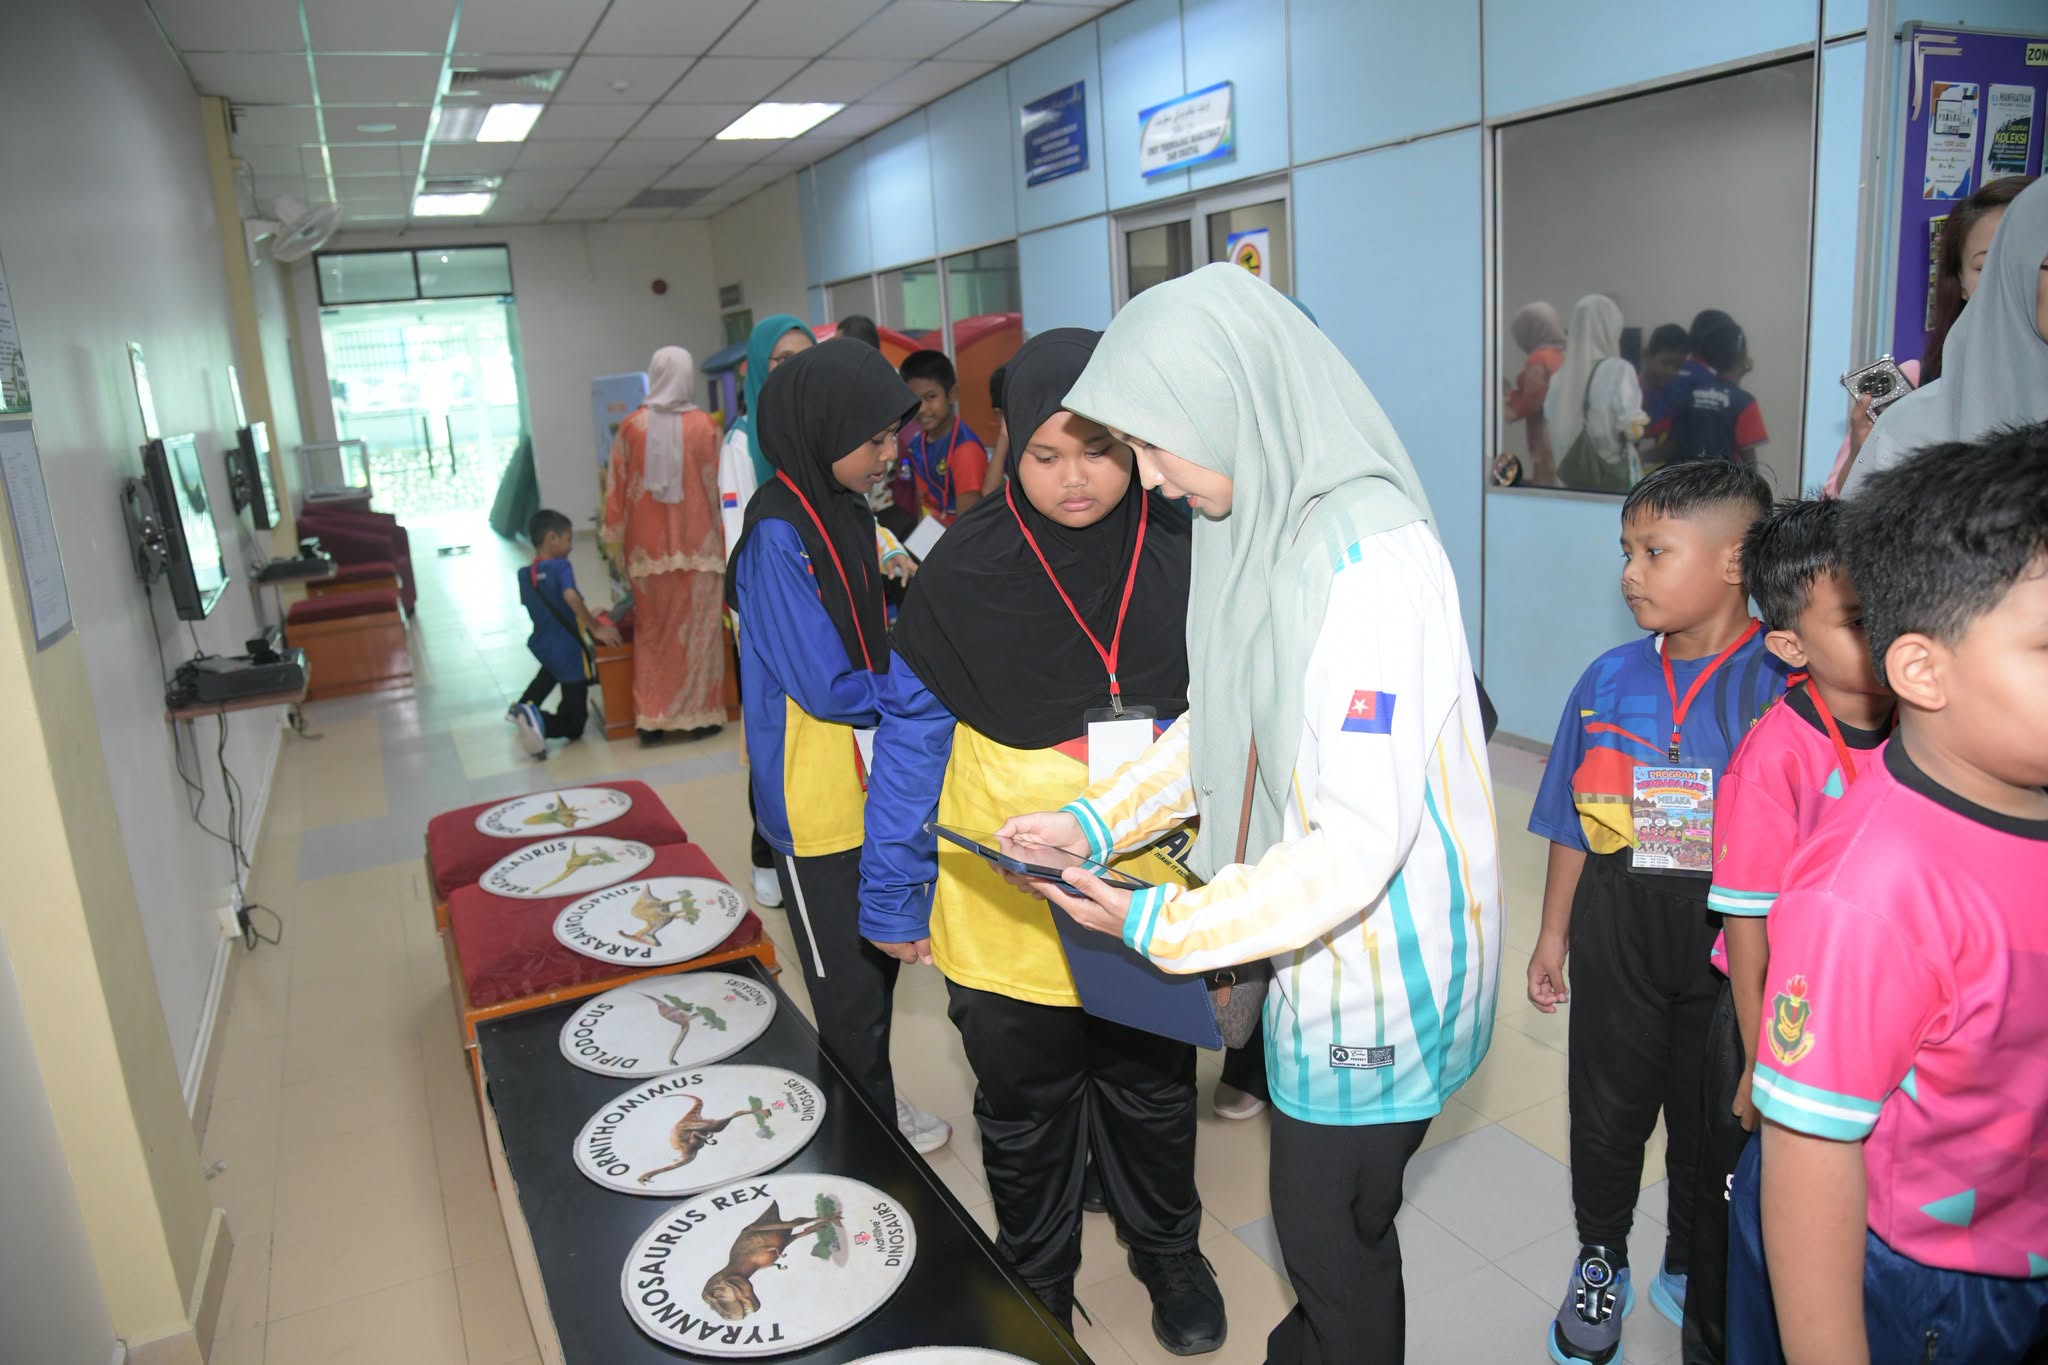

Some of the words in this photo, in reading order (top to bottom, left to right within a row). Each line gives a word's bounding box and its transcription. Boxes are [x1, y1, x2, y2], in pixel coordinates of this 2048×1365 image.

[1995, 132, 2028, 145] KOLEKSI
[1636, 778, 1683, 790] KEMBARA
[1648, 769, 1698, 781] PROGRAM
[1657, 794, 1692, 805] MELAKA
[563, 884, 652, 959] PARASAUROLOPHUS
[573, 1002, 640, 1070] DIPLODOCUS
[590, 1073, 704, 1177] ORNITHOMIMUS
[784, 1078, 815, 1121] DINOSAURS
[873, 1202, 905, 1267] DINOSAURS
[637, 1208, 784, 1345] TYRANNOSAURUS
[711, 1182, 771, 1211] REX
